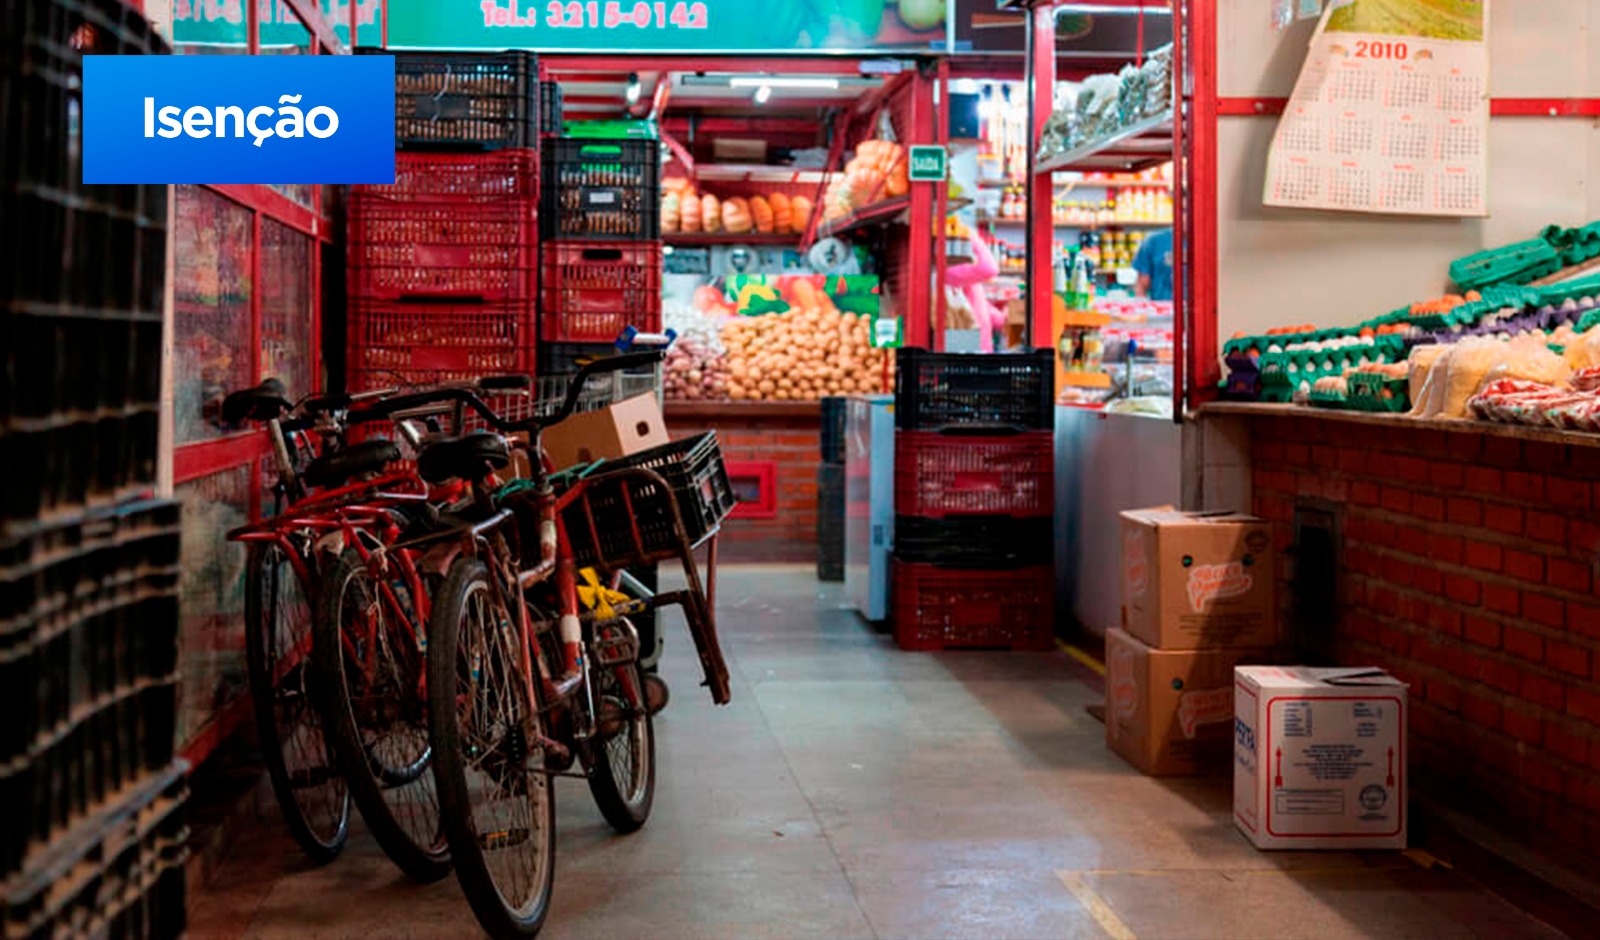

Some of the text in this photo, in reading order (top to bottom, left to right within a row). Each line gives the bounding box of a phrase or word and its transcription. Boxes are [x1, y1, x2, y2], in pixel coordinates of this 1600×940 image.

[480, 0, 708, 29] Tel.: 3215-0142
[1355, 40, 1408, 60] 2010
